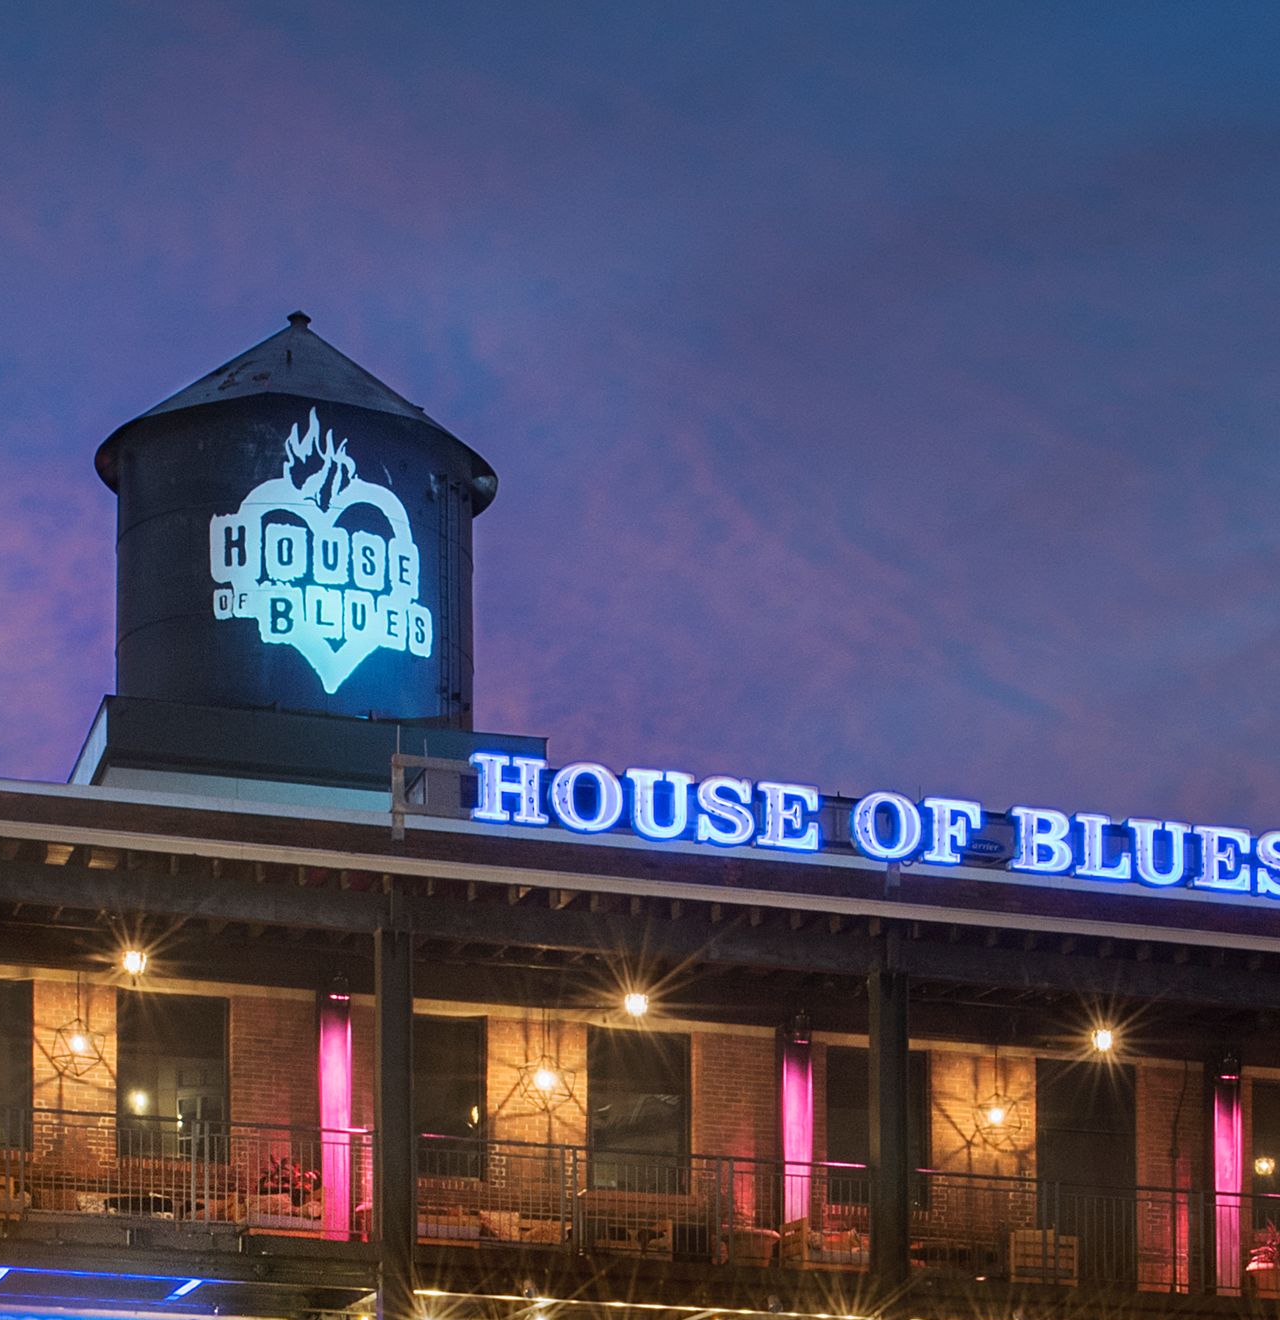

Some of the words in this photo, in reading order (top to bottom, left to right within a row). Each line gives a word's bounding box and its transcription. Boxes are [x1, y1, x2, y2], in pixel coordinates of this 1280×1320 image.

[223, 523, 412, 585] HOUSE
[218, 591, 249, 613] OF
[270, 597, 427, 645] BLUES
[469, 752, 820, 854] HOUSE
[850, 790, 982, 865] OF
